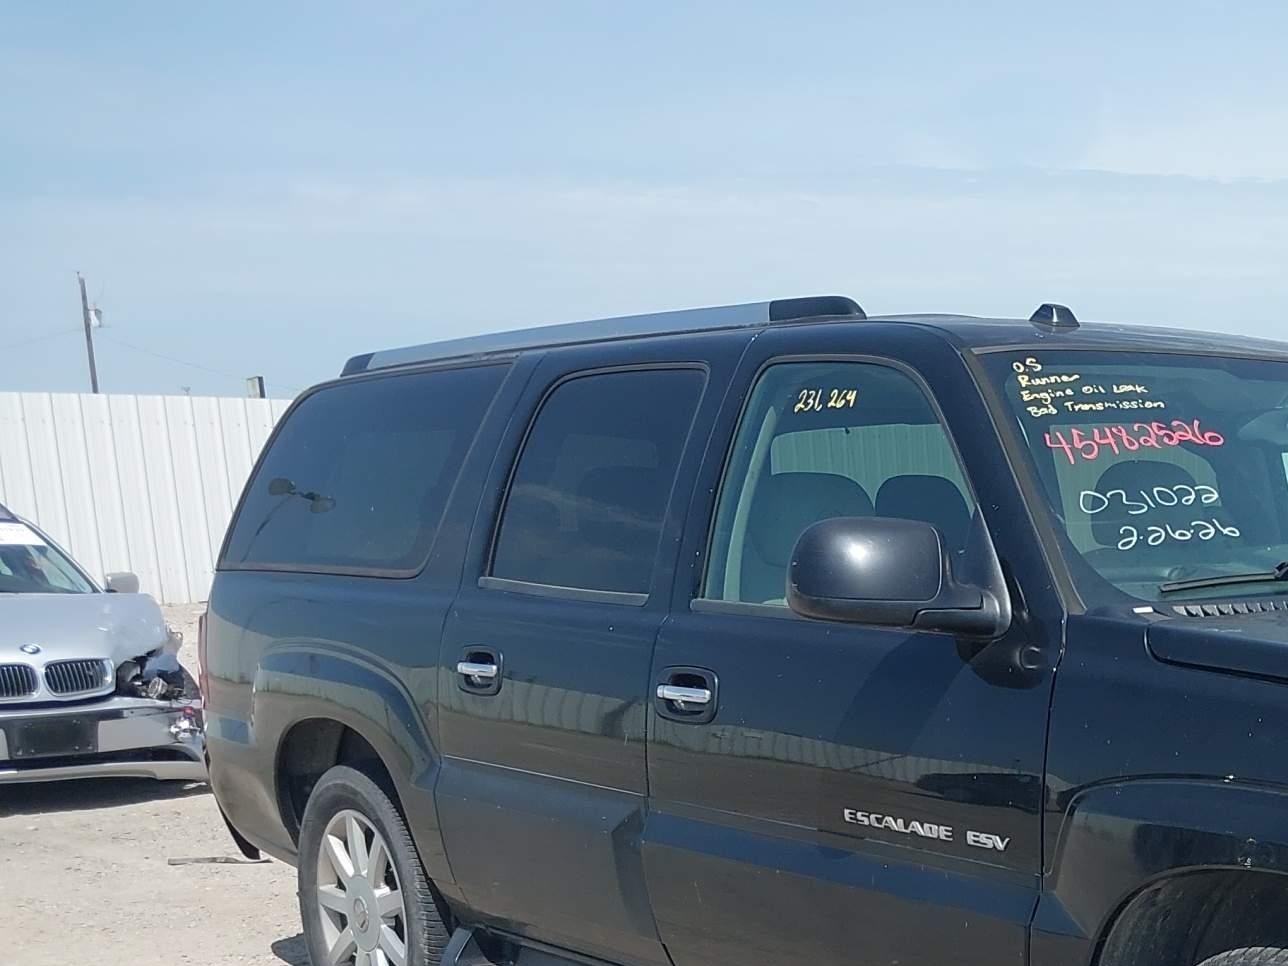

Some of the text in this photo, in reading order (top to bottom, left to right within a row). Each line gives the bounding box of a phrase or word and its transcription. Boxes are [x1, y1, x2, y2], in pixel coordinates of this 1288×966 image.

[1017, 374, 1080, 388] Runner
[1020, 389, 1074, 404] Engine
[1081, 384, 1106, 394] Oil
[1026, 400, 1165, 417] Bad Transmission
[1043, 419, 1225, 465] 45482526
[1079, 485, 1219, 514] 031022
[843, 808, 1010, 851] ESCALADE ESV
